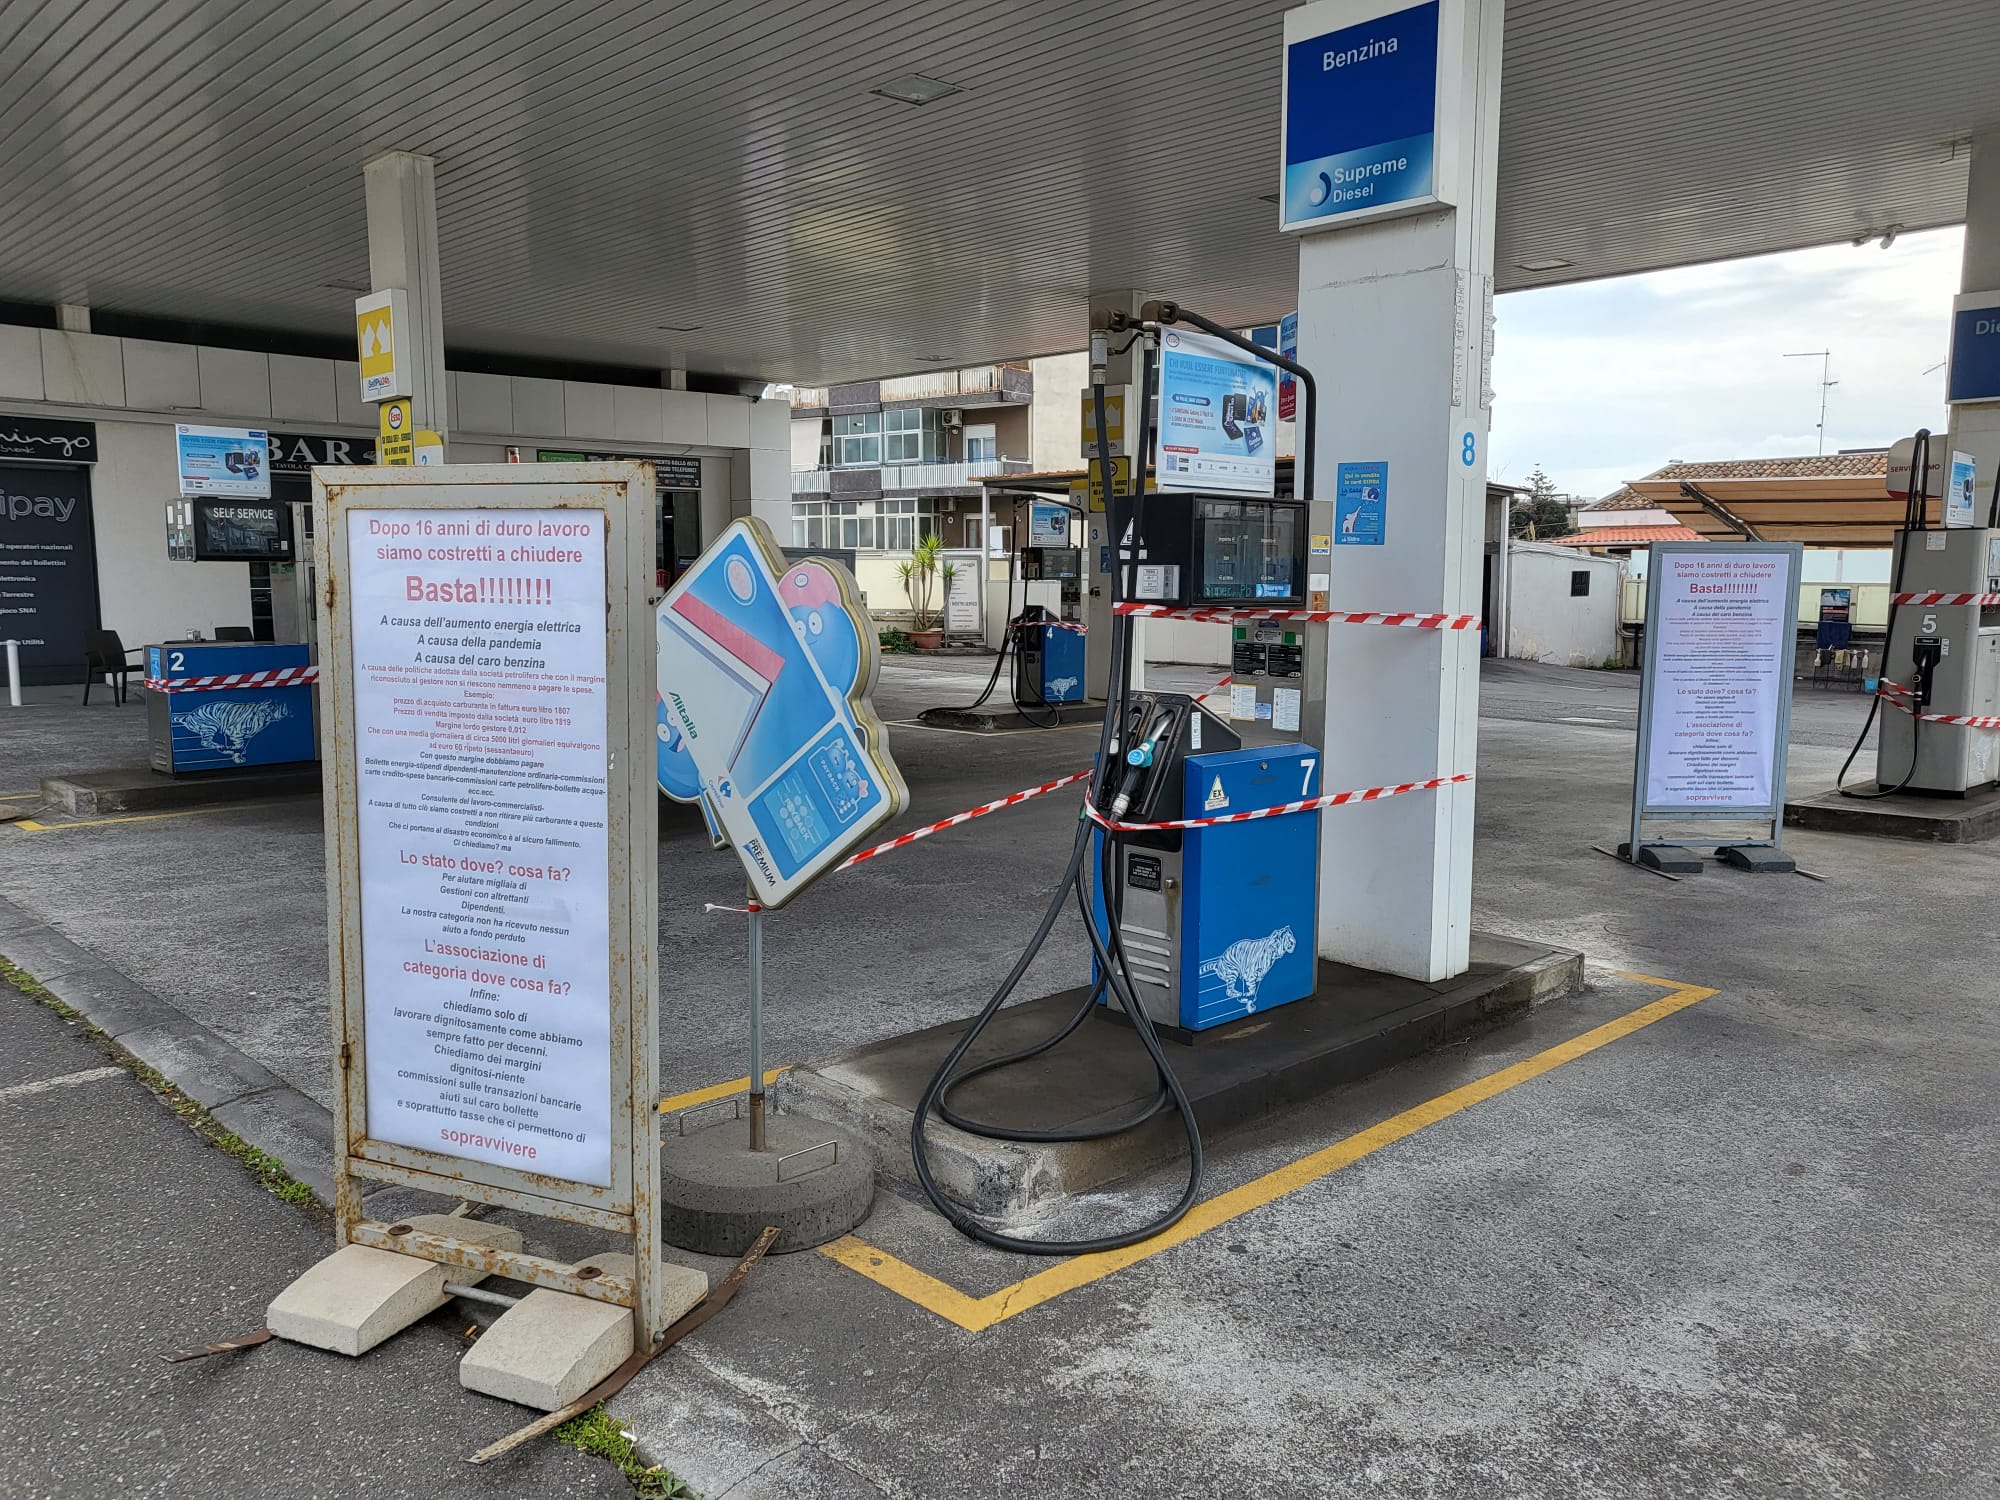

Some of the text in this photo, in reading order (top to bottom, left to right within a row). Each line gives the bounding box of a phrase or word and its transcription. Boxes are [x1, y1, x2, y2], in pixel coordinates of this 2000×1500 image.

[1323, 37, 1398, 72] Benzina
[1334, 157, 1408, 184] Supreme
[1333, 183, 1374, 203] Diesel
[268, 436, 355, 464] BAR
[1462, 431, 1476, 467] 8
[213, 507, 274, 520] SELF SERVICE
[1076, 496, 1082, 506] 3
[369, 519, 590, 539] Dopo 16 anni di duro lavoro
[1092, 529, 1098, 540] 3
[376, 543, 582, 563] siamo costretti a chiudere
[379, 614, 581, 634] A causa dell'aumento energia elettrica
[1046, 627, 1053, 640] 4
[1922, 614, 1937, 635] 5
[416, 633, 542, 650] A causa della pandemia
[170, 652, 185, 672] 2
[414, 651, 545, 669] A causa del caro benzina
[668, 691, 698, 740] Alitalia
[1300, 758, 1316, 796] 7
[1212, 789, 1222, 798] EX
[399, 849, 571, 882] Lo stato dove? cosa fa?
[749, 839, 776, 887] PREMIUM
[401, 905, 569, 936] La nostra categoria non ha ricevuto nessun
[442, 924, 461, 934] aiuto
[469, 927, 493, 938] fondo
[494, 932, 525, 943] perduto
[424, 938, 545, 969] L'associazione di
[402, 960, 571, 996] categoria dove cosa fa?
[442, 999, 528, 1023] chiediamo solo di
[393, 1006, 583, 1047] lavorare dignitosamente come abbiamo
[425, 1029, 547, 1057] sempre fatto per decenni.
[434, 1043, 542, 1071] Chiediamo dei margini
[449, 1062, 525, 1084] dignitosi-niente
[397, 1069, 582, 1111] commissioni sulle transazioni bancarie
[439, 1091, 539, 1118] aiuti sul caro bollette
[397, 1099, 586, 1143] e soprattutto tasse che ci permettono di
[440, 1128, 536, 1159] sopravvivere
